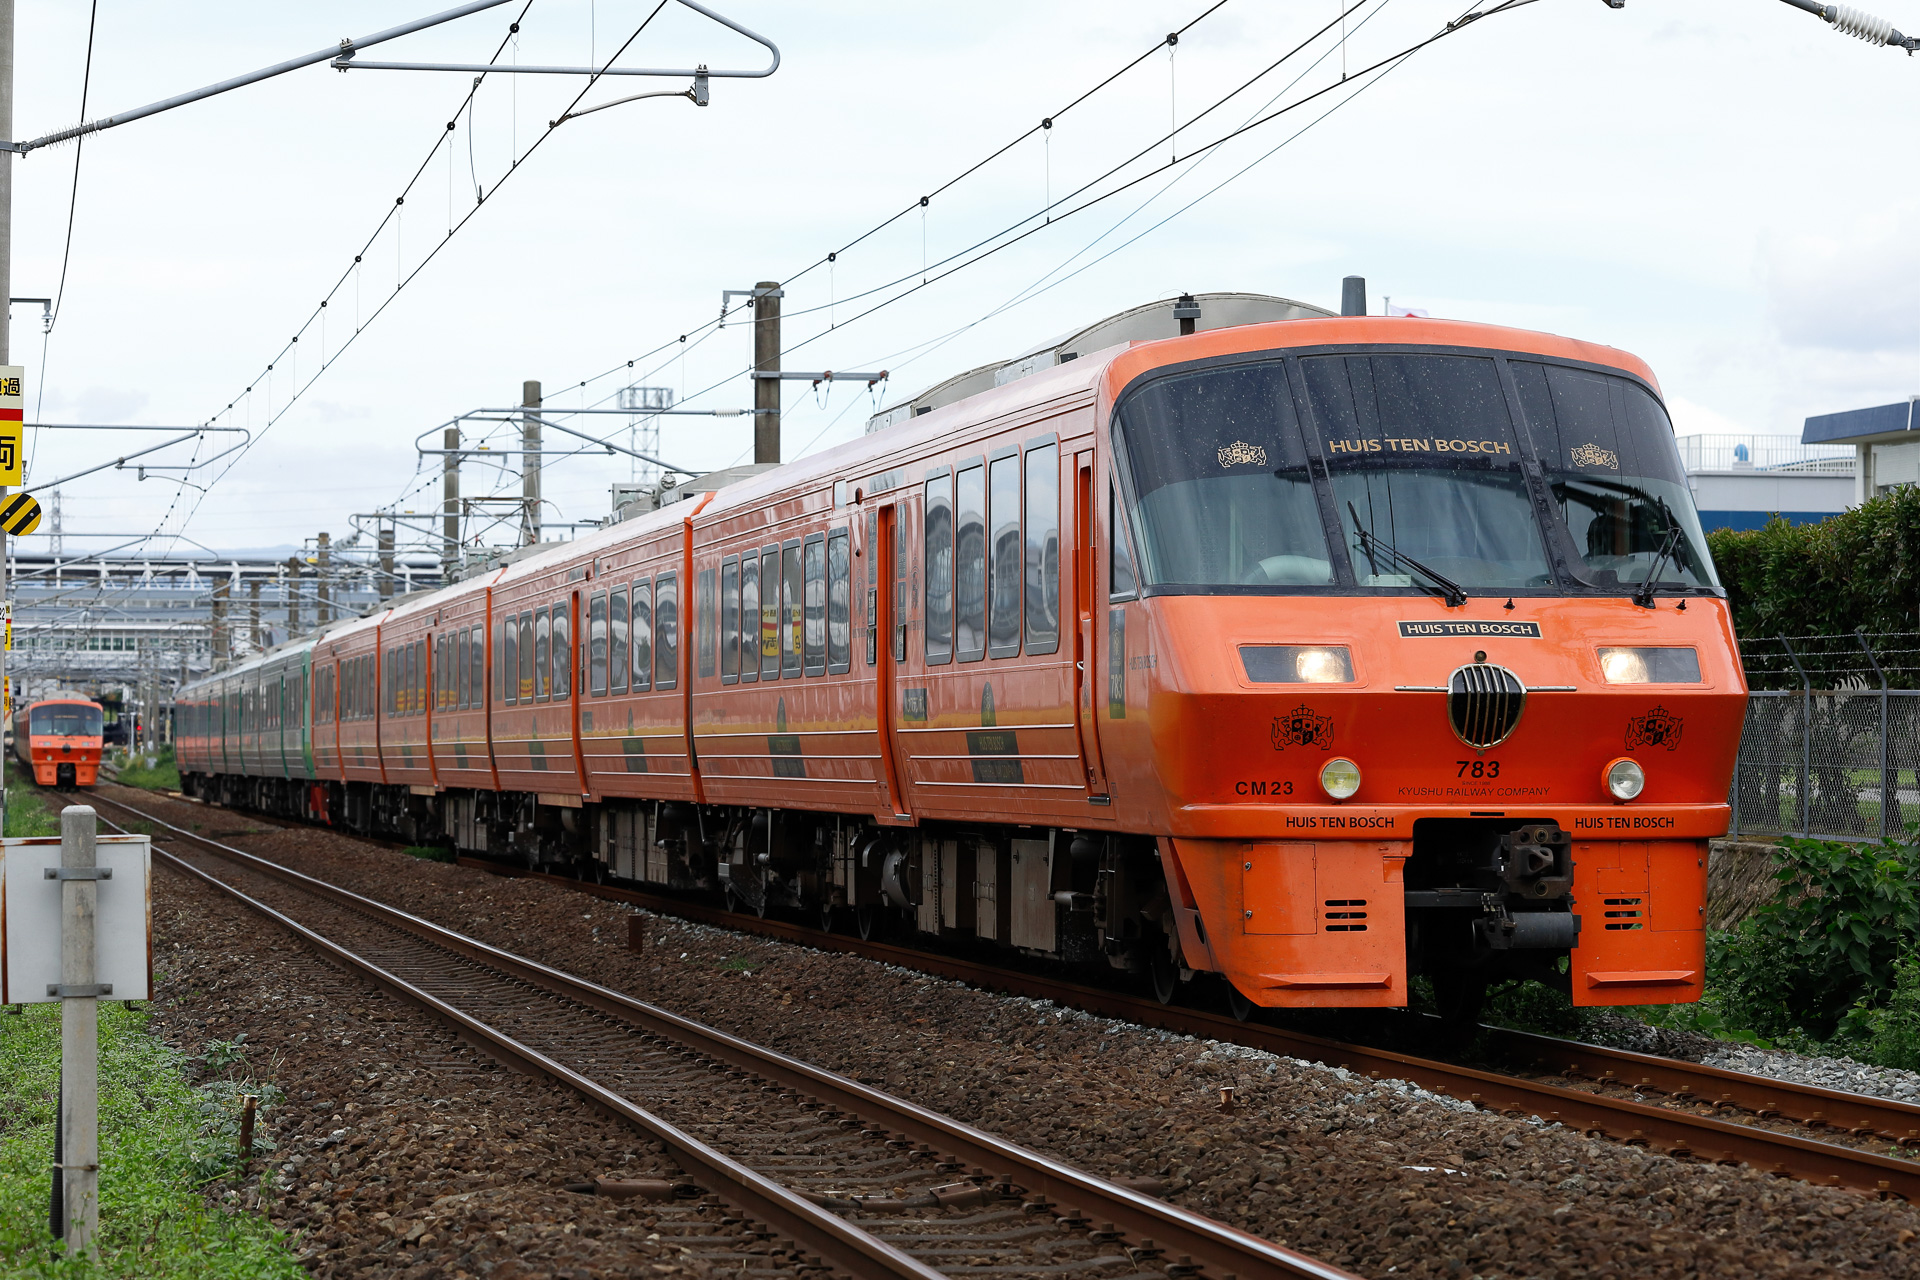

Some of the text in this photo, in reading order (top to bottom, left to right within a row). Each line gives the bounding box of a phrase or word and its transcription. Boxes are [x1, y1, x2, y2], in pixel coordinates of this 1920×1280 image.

[0, 377, 20, 396] 過
[1329, 438, 1511, 454] HUIS TEN BOSCH
[1406, 624, 1533, 635] HUIS TEN BOSCH
[1111, 674, 1123, 699] 783
[1456, 760, 1500, 778] 783
[1398, 787, 1550, 796] KYUSHU RAILWAY COMPANY
[1286, 817, 1395, 828] HUIS TEN BOSCH
[1575, 817, 1675, 828] HUIS TEN BOSCH
